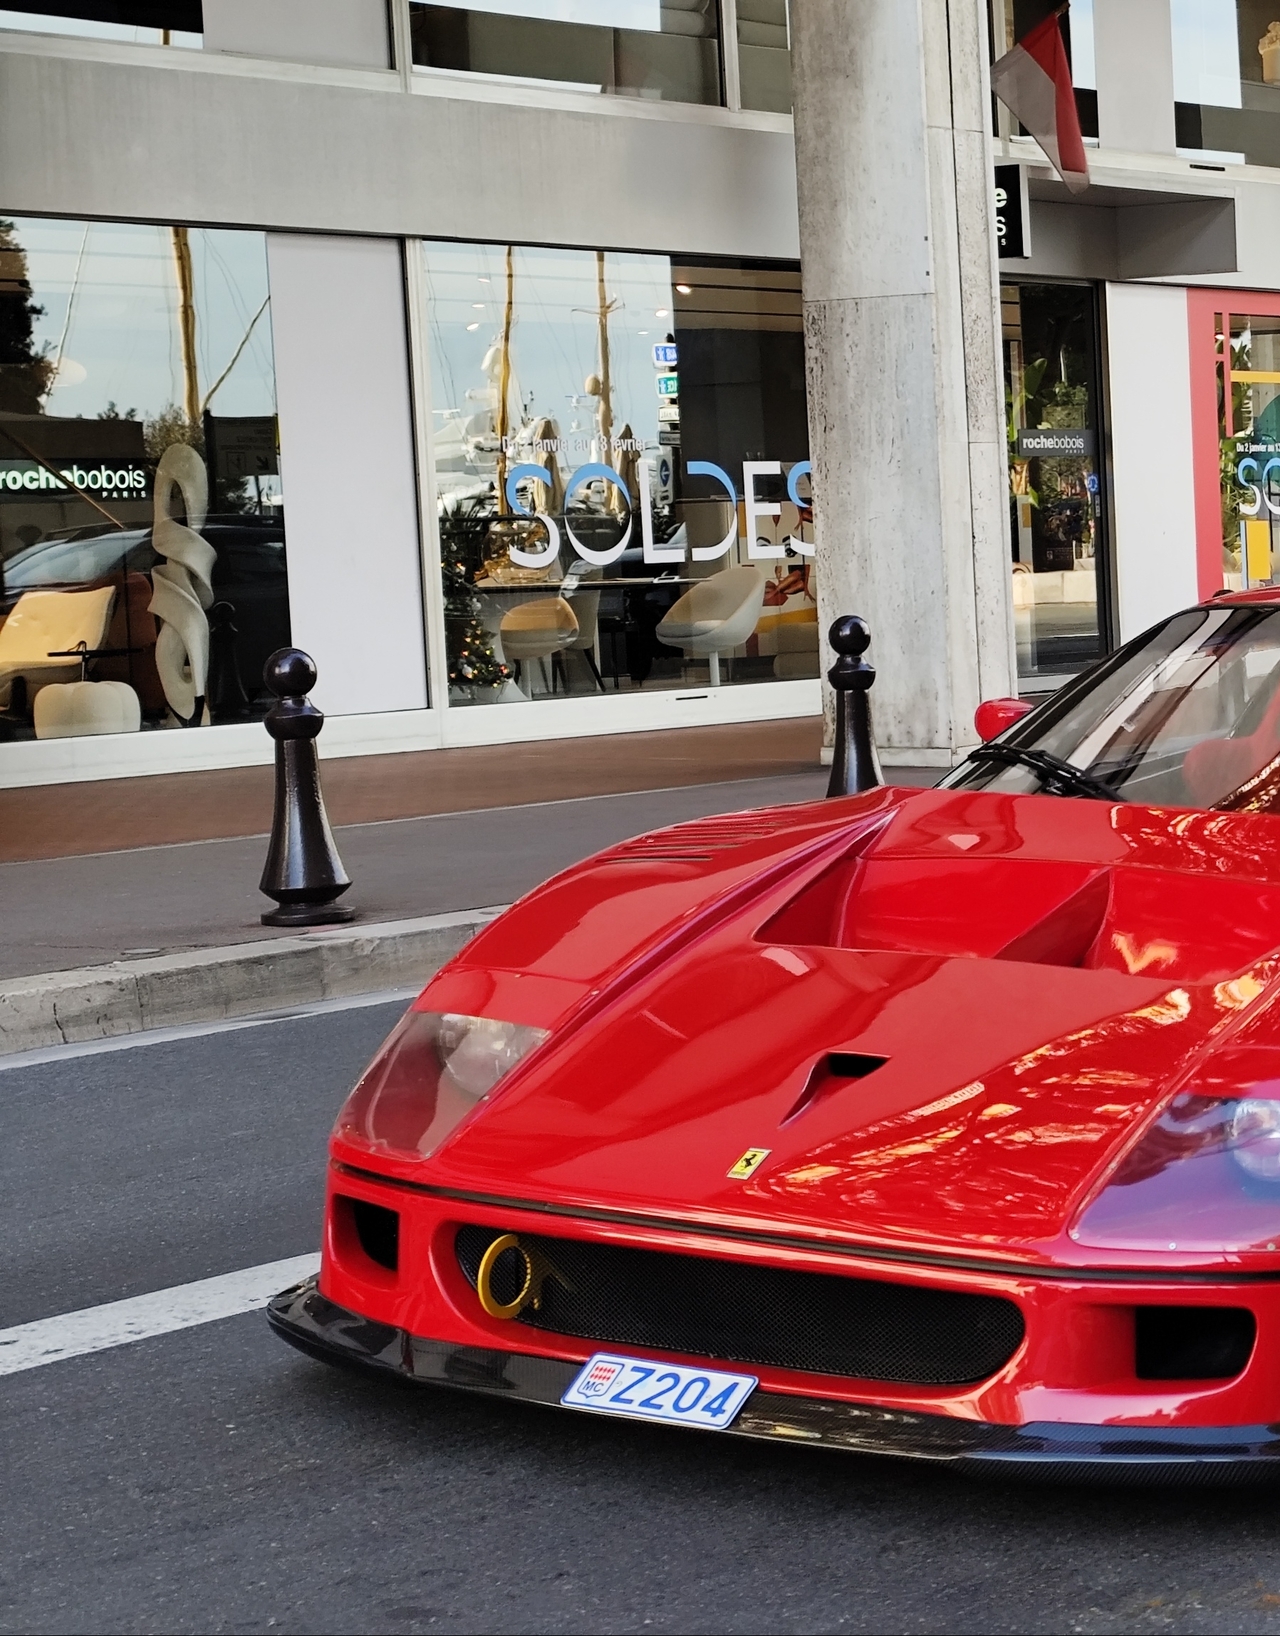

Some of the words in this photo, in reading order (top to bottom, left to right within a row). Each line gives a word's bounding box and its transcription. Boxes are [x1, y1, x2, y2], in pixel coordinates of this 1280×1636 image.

[575, 438, 589, 452] au
[1022, 434, 1084, 449] rochebobois
[1236, 442, 1245, 453] Du
[1249, 442, 1267, 455] janvier
[102, 491, 147, 499] PARIS
[582, 1380, 604, 1393] MC
[609, 1366, 740, 1418] Z204
